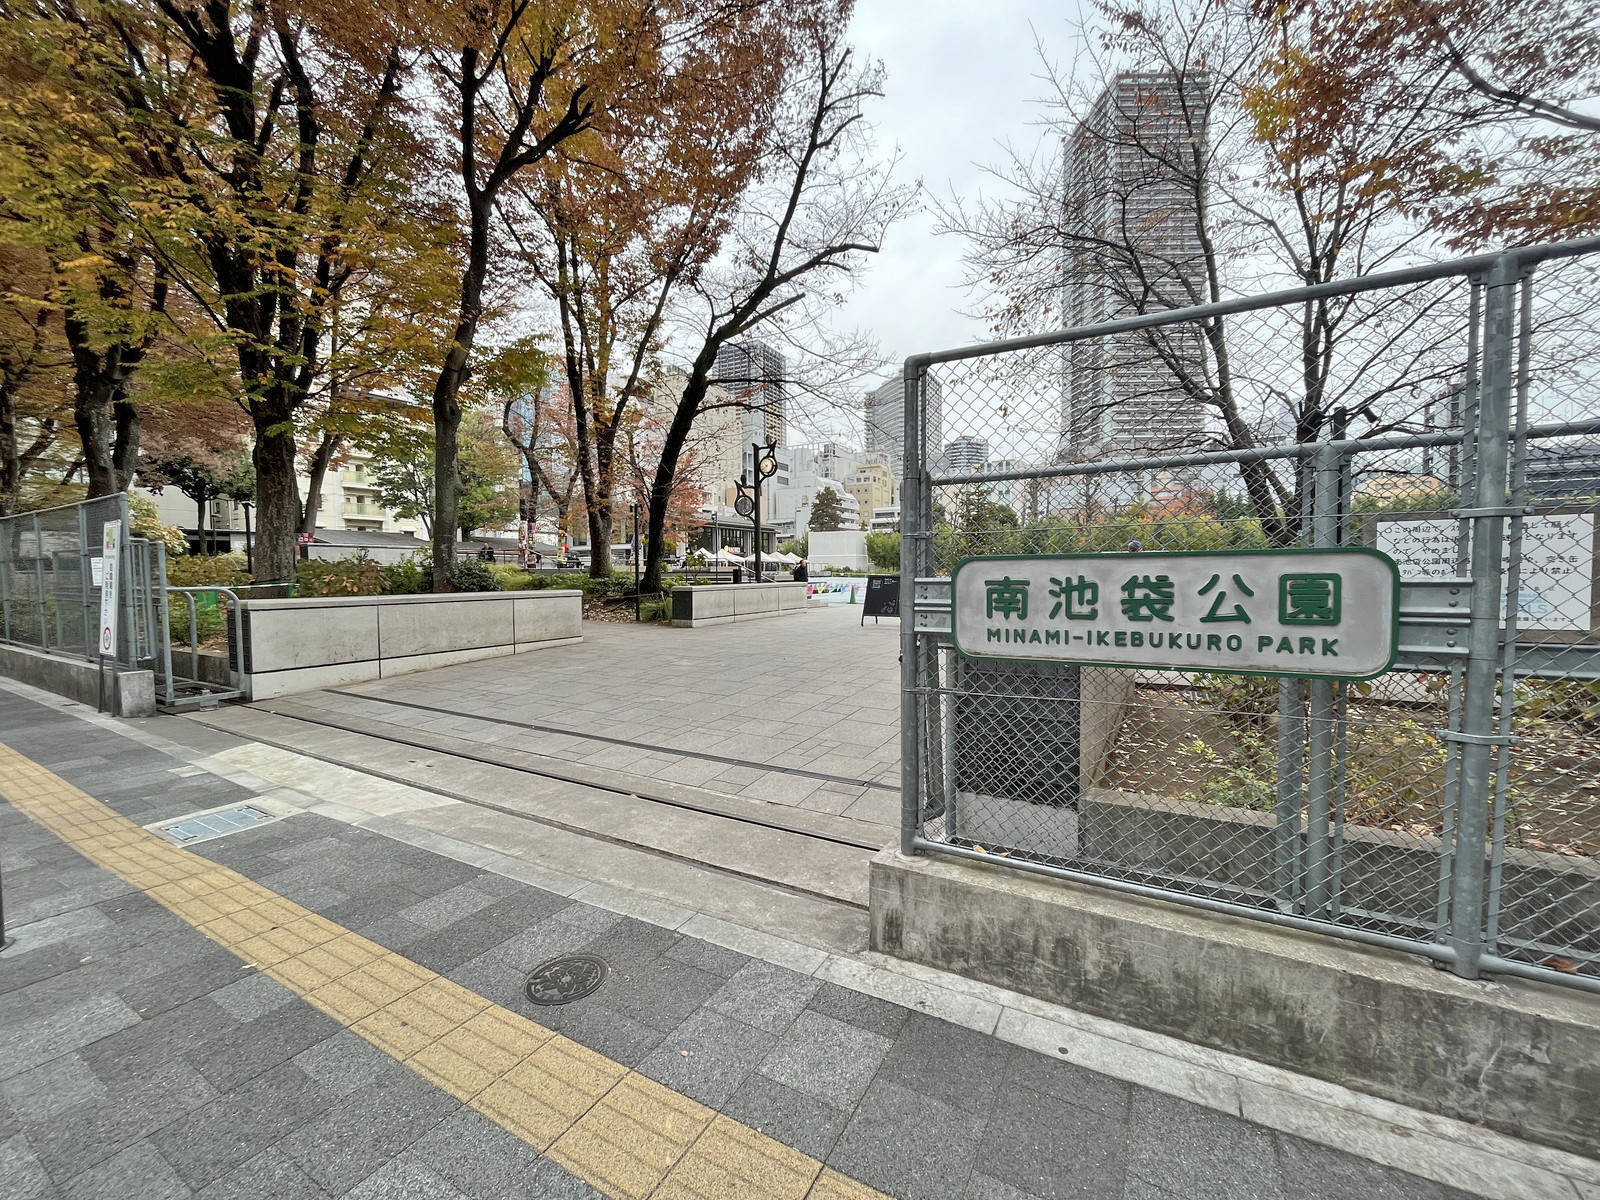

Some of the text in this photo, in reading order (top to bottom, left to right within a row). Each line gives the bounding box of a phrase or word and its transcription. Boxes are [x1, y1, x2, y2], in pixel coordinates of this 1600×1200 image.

[985, 573, 1342, 626] 南池袋公園
[987, 628, 1339, 657] MINAMI-IKEBUKURO PARK
